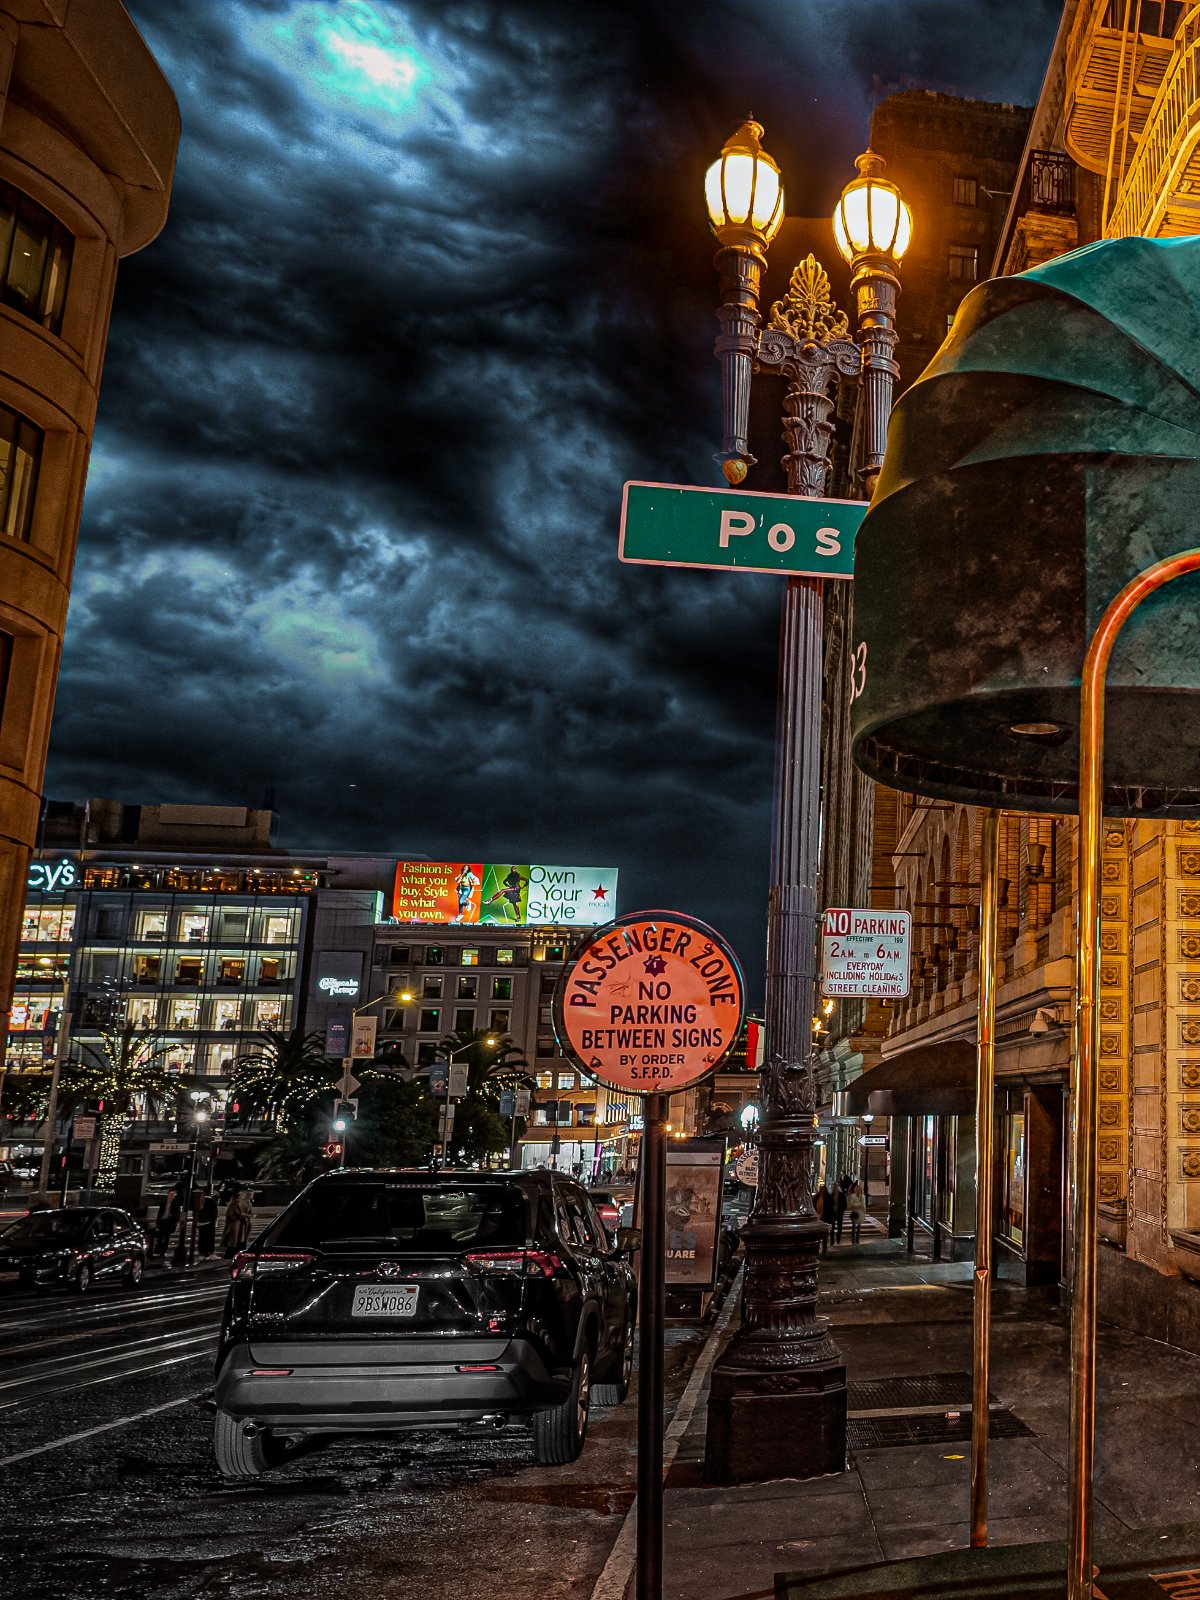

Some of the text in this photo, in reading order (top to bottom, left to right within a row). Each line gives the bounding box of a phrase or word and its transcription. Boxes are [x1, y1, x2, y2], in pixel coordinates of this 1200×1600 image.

[718, 510, 842, 556] Pos
[403, 863, 453, 875] Fashion is
[529, 866, 576, 884] Own
[402, 875, 448, 887] what you
[400, 886, 449, 899] buy. Style
[541, 884, 582, 902] Your
[400, 897, 436, 908] is what
[398, 909, 445, 920] you own.
[528, 901, 576, 923] Style
[826, 912, 906, 935] NO PARKING
[569, 927, 736, 1008] PASSENGER ZONE
[846, 962, 885, 971] EVERYDAY
[826, 971, 866, 980] INCLUDING
[638, 981, 672, 1001] NO
[828, 984, 902, 994] STREET CLEANING
[610, 1004, 697, 1025] PARKING
[581, 1027, 723, 1050] BETWEEN SIGNS
[619, 1054, 685, 1066] BY ORDER
[630, 1066, 674, 1079] S.F.P.D.
[356, 1296, 413, 1311] 9BSW086
